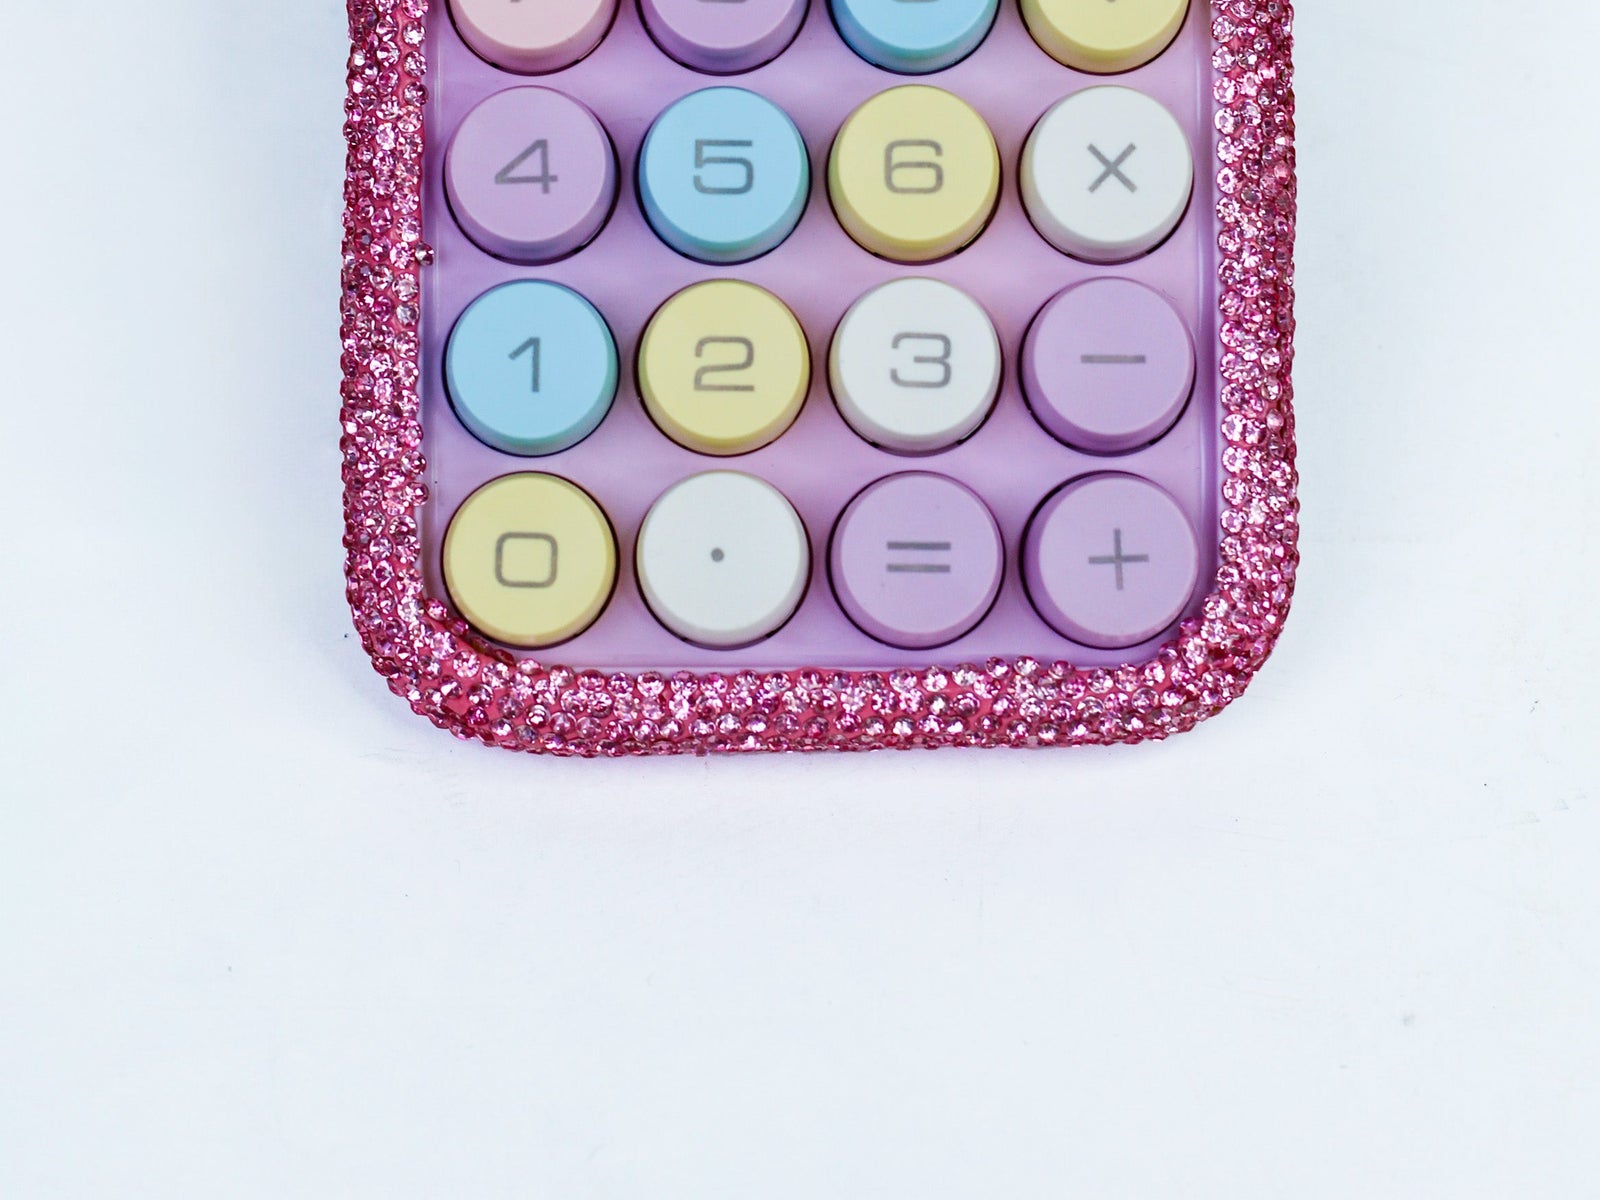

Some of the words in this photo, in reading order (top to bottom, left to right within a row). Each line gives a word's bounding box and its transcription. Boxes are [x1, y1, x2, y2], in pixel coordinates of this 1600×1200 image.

[495, 139, 558, 194] 4
[693, 139, 755, 195] 5
[884, 139, 944, 195] 6
[508, 336, 541, 393] 1
[693, 336, 755, 393] 2
[889, 332, 952, 389] 3
